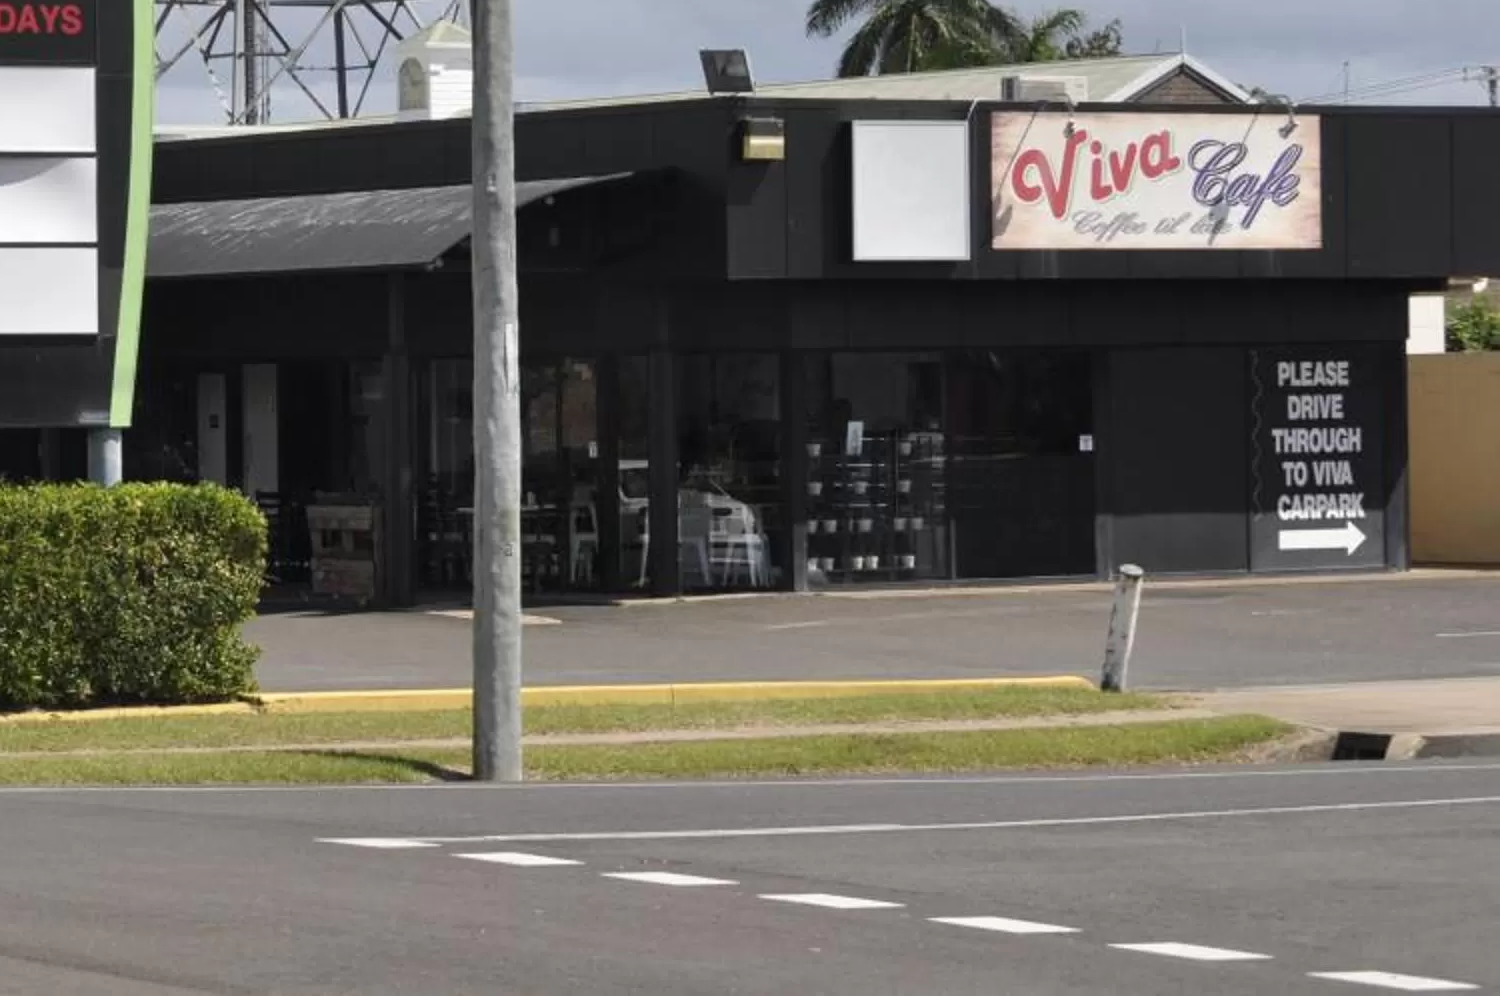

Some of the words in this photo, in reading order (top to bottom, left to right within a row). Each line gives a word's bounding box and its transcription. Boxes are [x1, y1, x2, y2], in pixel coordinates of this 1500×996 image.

[1011, 129, 1181, 219] Viva
[1072, 209, 1147, 242] Coffee
[1277, 360, 1350, 387] PLEASE
[1287, 393, 1345, 420] DRIVE
[1271, 427, 1363, 454] THROUGH
[1281, 461, 1308, 487] TO
[1312, 460, 1354, 486] VIVA
[1277, 492, 1366, 521] CARPARK
